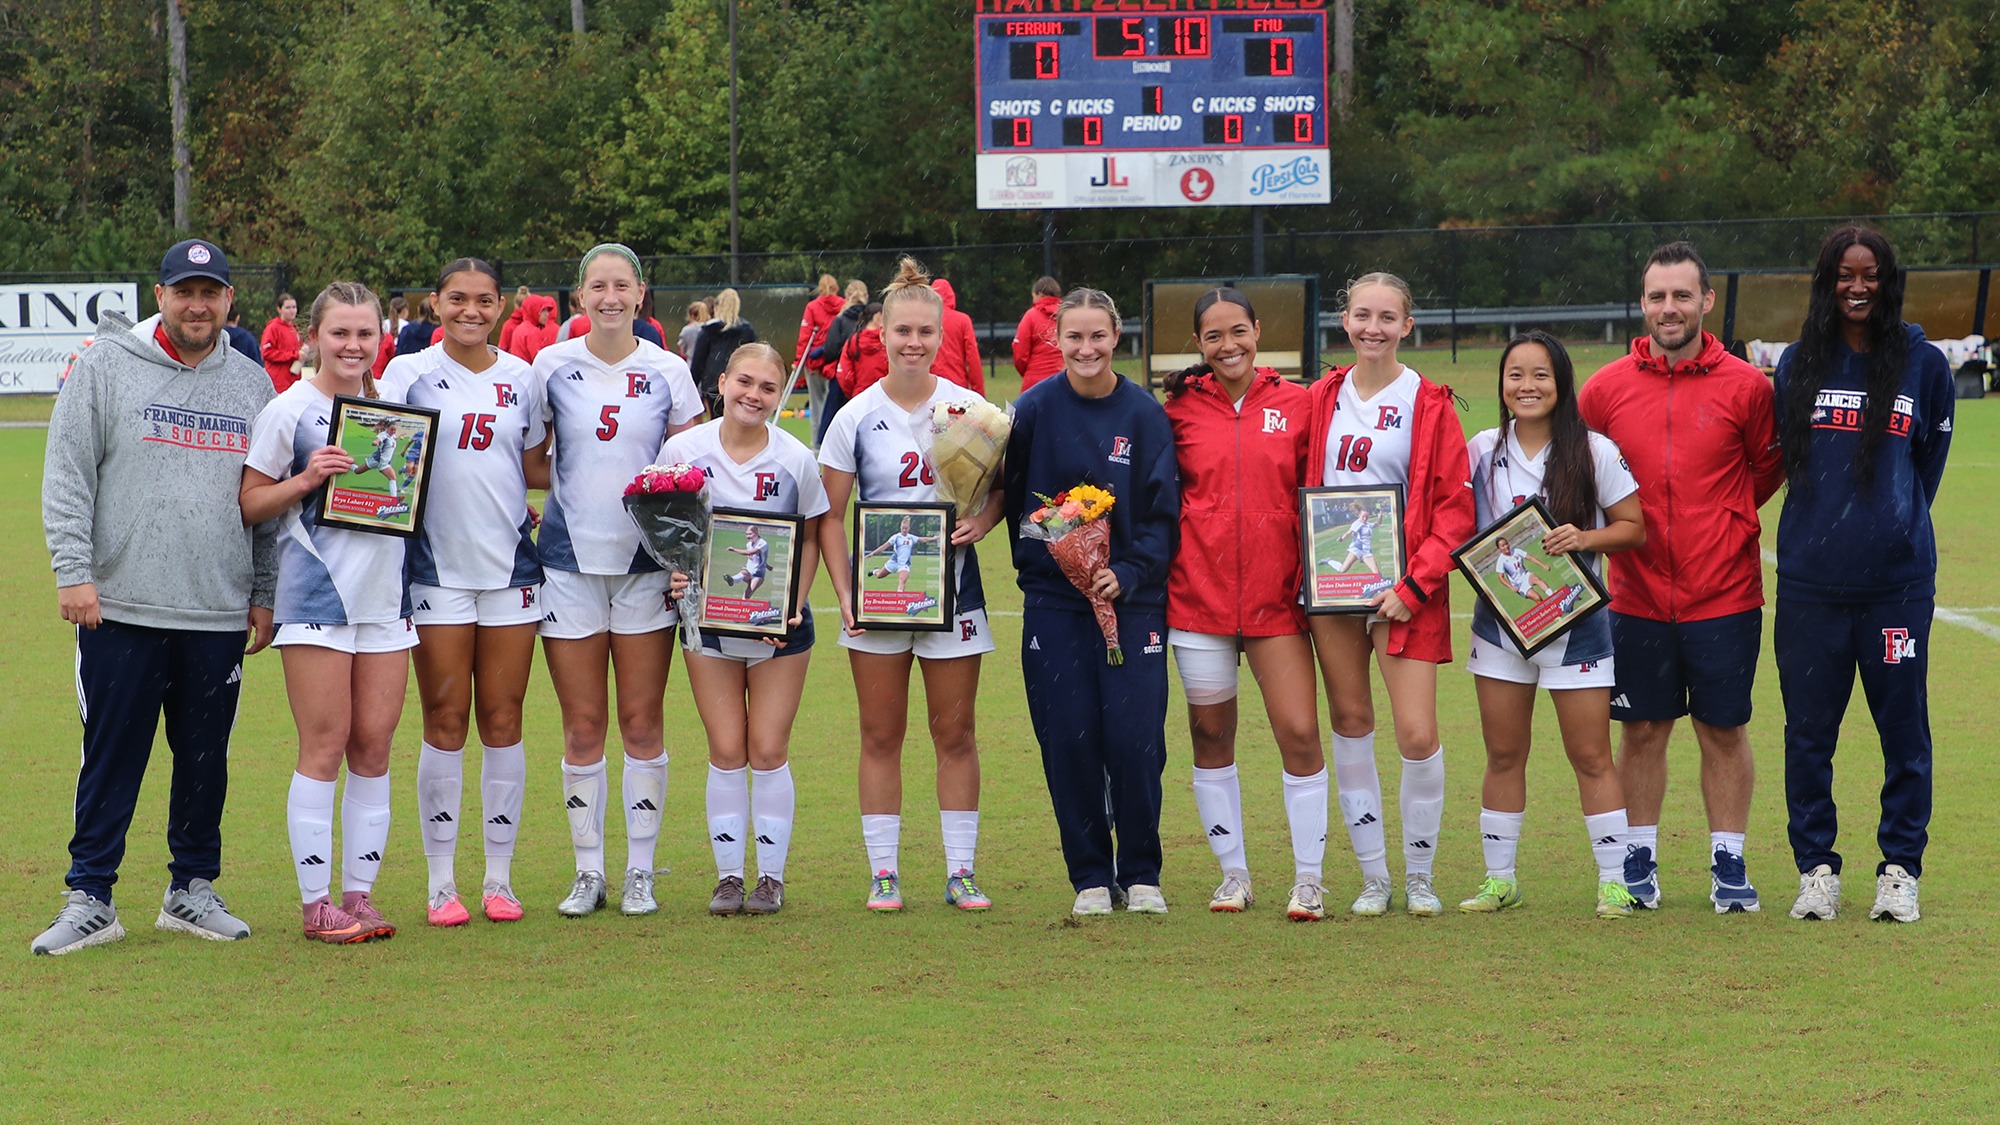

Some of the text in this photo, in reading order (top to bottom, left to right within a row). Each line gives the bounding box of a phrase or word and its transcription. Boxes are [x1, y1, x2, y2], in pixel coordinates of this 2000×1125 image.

[1006, 22, 1063, 36] FERRUM
[1122, 18, 1208, 56] 5:10
[1254, 18, 1283, 32] FMU
[1035, 41, 1059, 79] 0
[1270, 38, 1294, 76] 0
[989, 99, 1042, 116] SHOTS
[1050, 98, 1115, 116] C KICKS
[1154, 86, 1162, 114] 1
[1192, 96, 1257, 114] C KICKS
[1263, 95, 1316, 112] SHOTS
[1013, 118, 1032, 147] 0
[1084, 116, 1102, 146] 0
[1122, 115, 1182, 132] PERIOD
[1224, 114, 1243, 143] 0
[1294, 113, 1313, 142] 0
[1090, 156, 1129, 187] JL
[1169, 153, 1224, 166] ZAXBY'S
[0, 289, 126, 328] ING
[144, 408, 247, 435] FRANCIS MARION
[458, 413, 496, 451] 15
[596, 405, 621, 442] 5
[1832, 408, 1912, 433] SOER
[172, 426, 248, 450] SOCCER
[1336, 434, 1373, 473] 18
[376, 504, 408, 516] Patriots
[1362, 578, 1392, 594] Patriots
[1559, 584, 1582, 612] Patriots
[749, 608, 780, 620] Patriots
[906, 598, 936, 612] Patriots
[1882, 628, 1916, 664] FM
